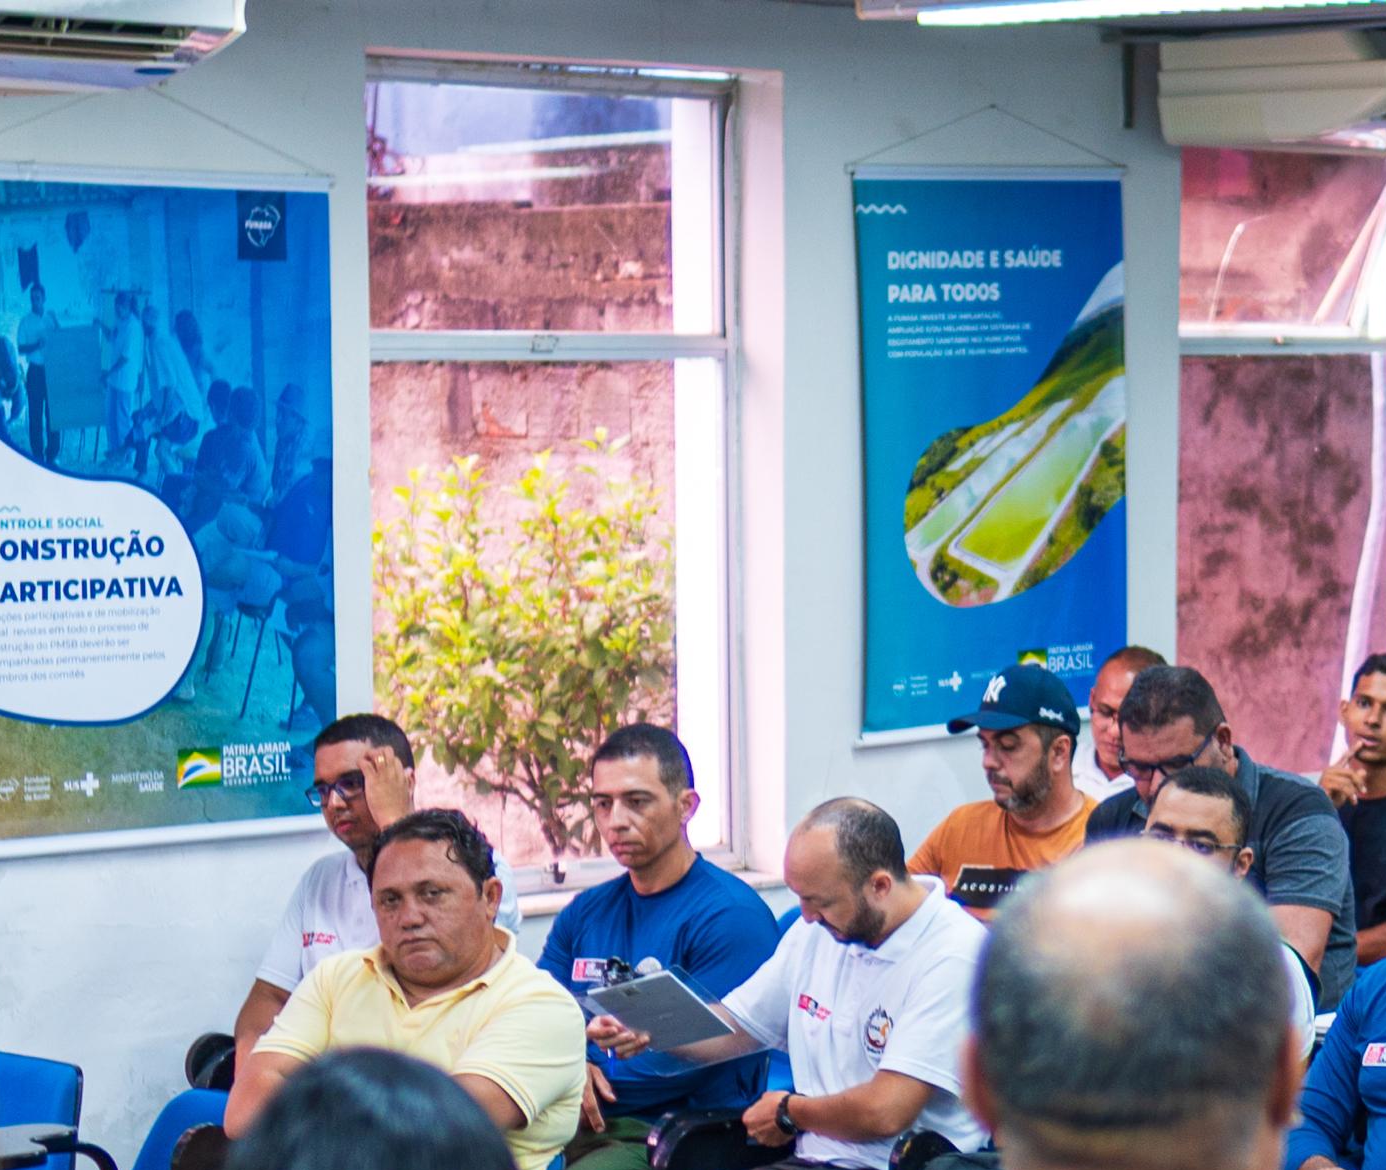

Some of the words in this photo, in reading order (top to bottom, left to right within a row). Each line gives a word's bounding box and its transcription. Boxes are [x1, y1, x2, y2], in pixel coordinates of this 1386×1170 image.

[887, 250, 985, 270] DIGNIDADE
[990, 250, 999, 268] E
[1004, 245, 1062, 268] SAÚDE
[888, 284, 937, 303] PARA
[941, 282, 1000, 302] TODOS
[57, 517, 103, 529] SOCIAL
[1047, 653, 1094, 673] BRASIL
[223, 743, 255, 757] PÁTRIA
[257, 741, 291, 755] AMADA
[223, 754, 291, 778] BRASIL
